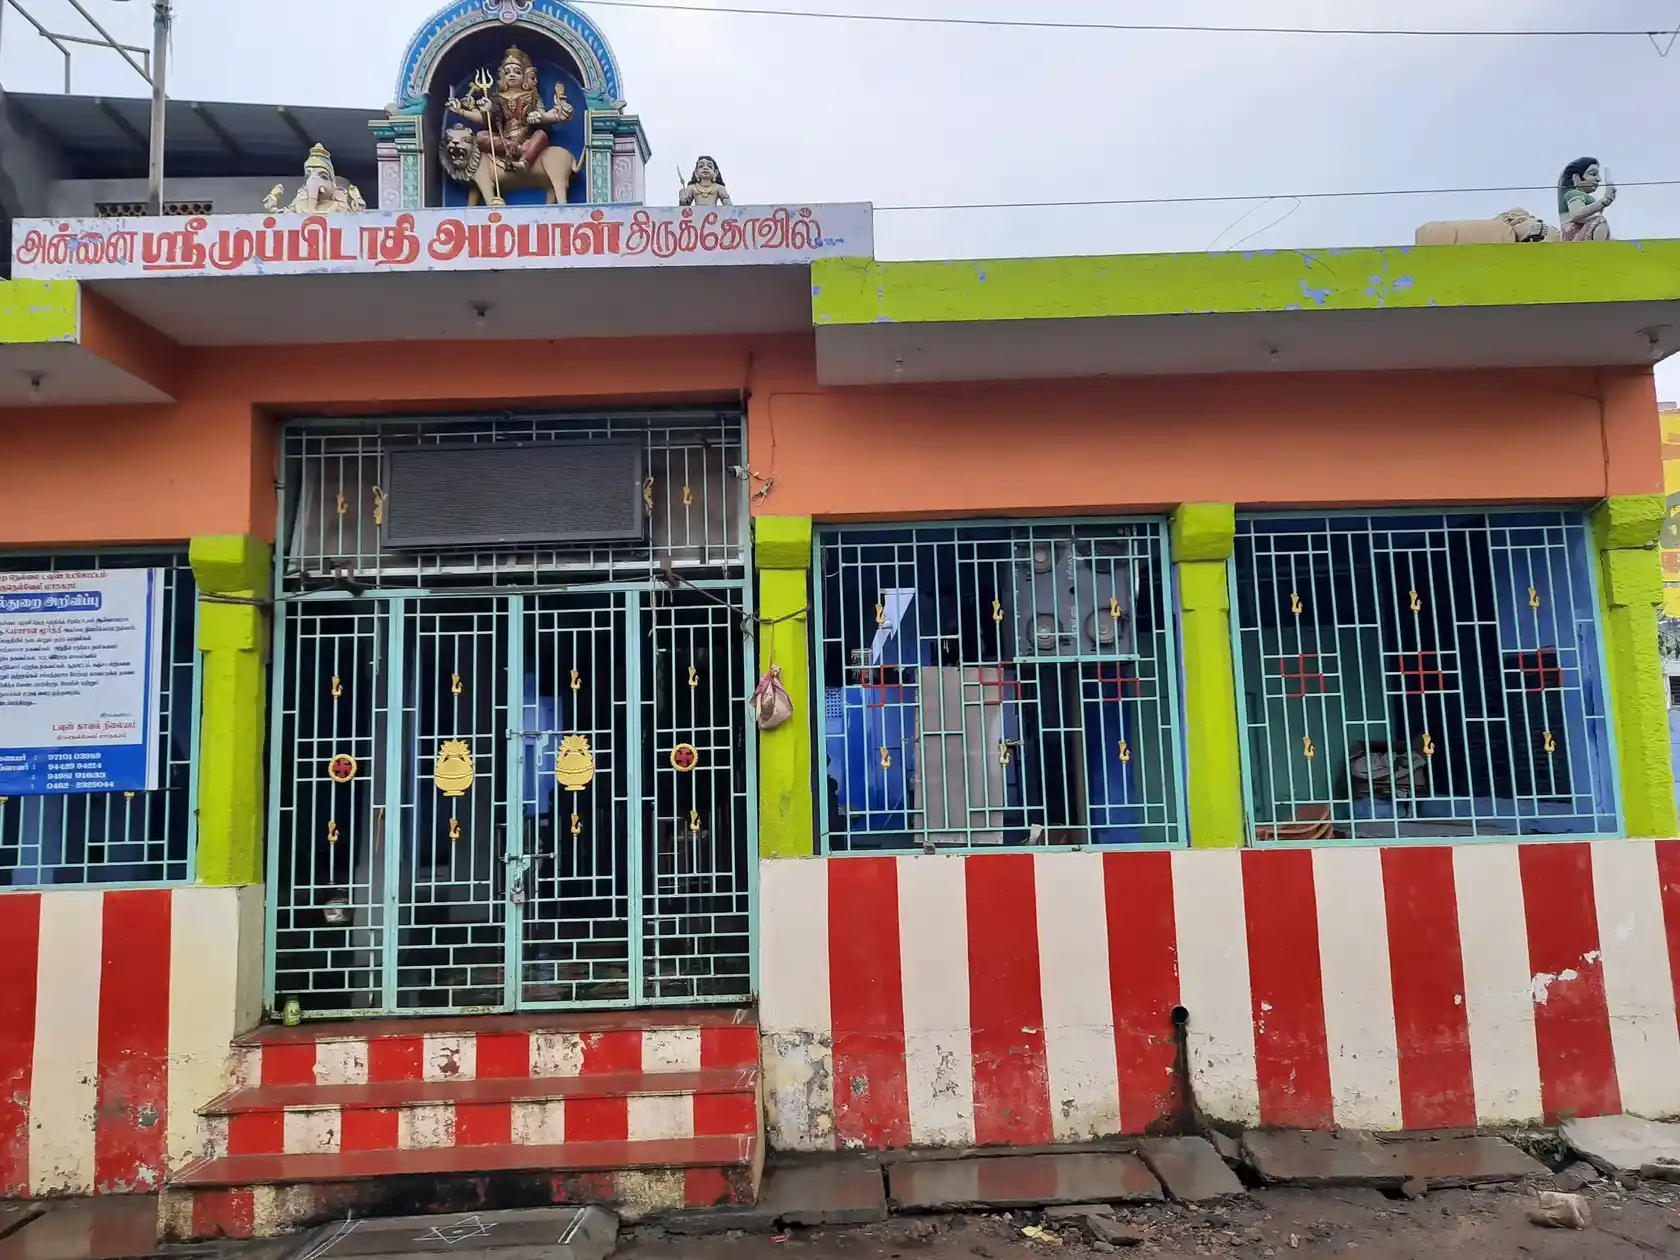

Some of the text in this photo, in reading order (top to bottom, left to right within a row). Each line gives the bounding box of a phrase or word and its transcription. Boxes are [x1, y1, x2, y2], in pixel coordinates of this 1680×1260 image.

[16, 222, 138, 266] அன்னை
[428, 209, 624, 261] அம்பாள்
[623, 207, 822, 259] திருக்கோவில்
[0, 595, 99, 611] ல்துறை அறிவிப்பு
